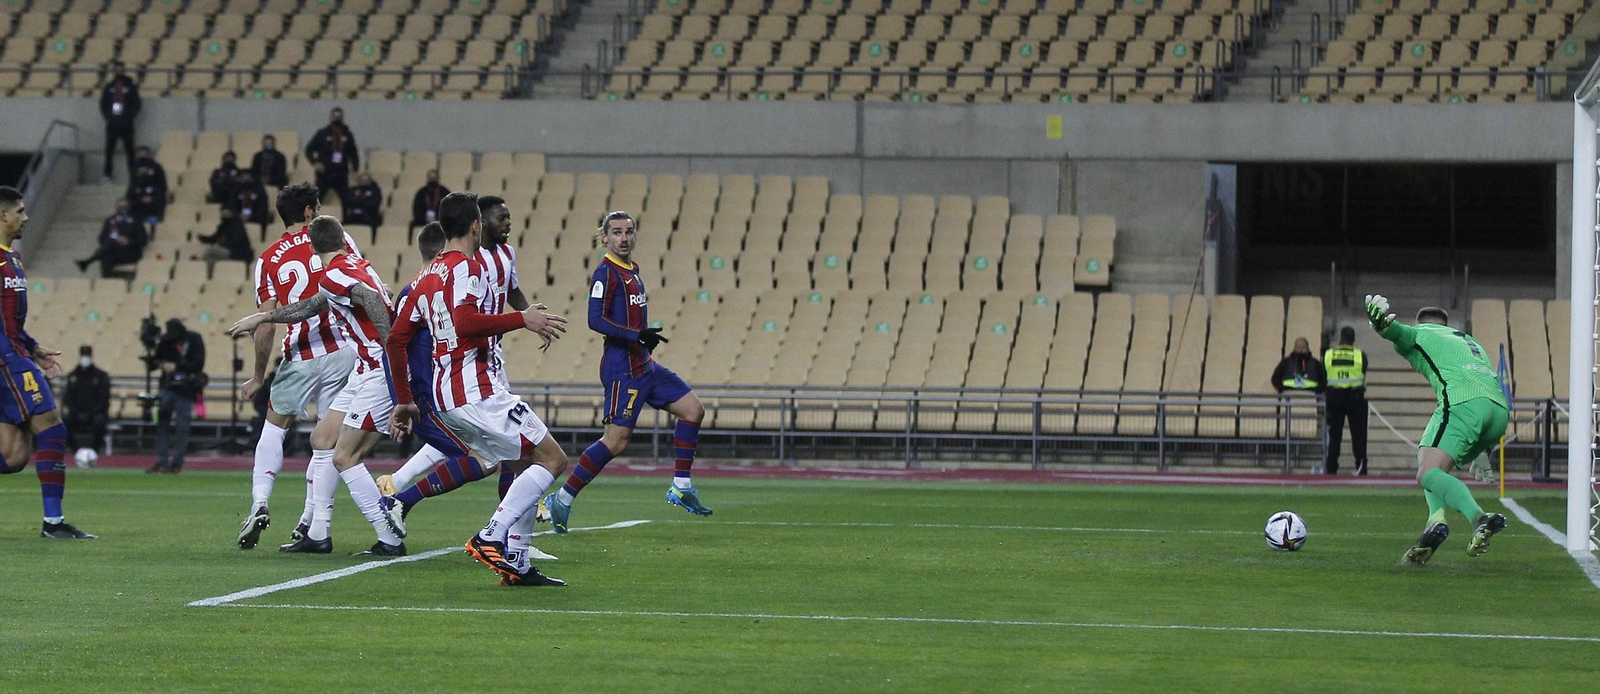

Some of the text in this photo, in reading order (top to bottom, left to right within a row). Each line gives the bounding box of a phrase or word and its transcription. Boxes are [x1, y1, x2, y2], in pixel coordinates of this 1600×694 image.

[293, 233, 311, 246] GA
[417, 290, 458, 353] 14
[22, 371, 39, 392] 4
[1338, 371, 1349, 379] 179
[627, 389, 638, 409] 7
[508, 403, 529, 426] 14
